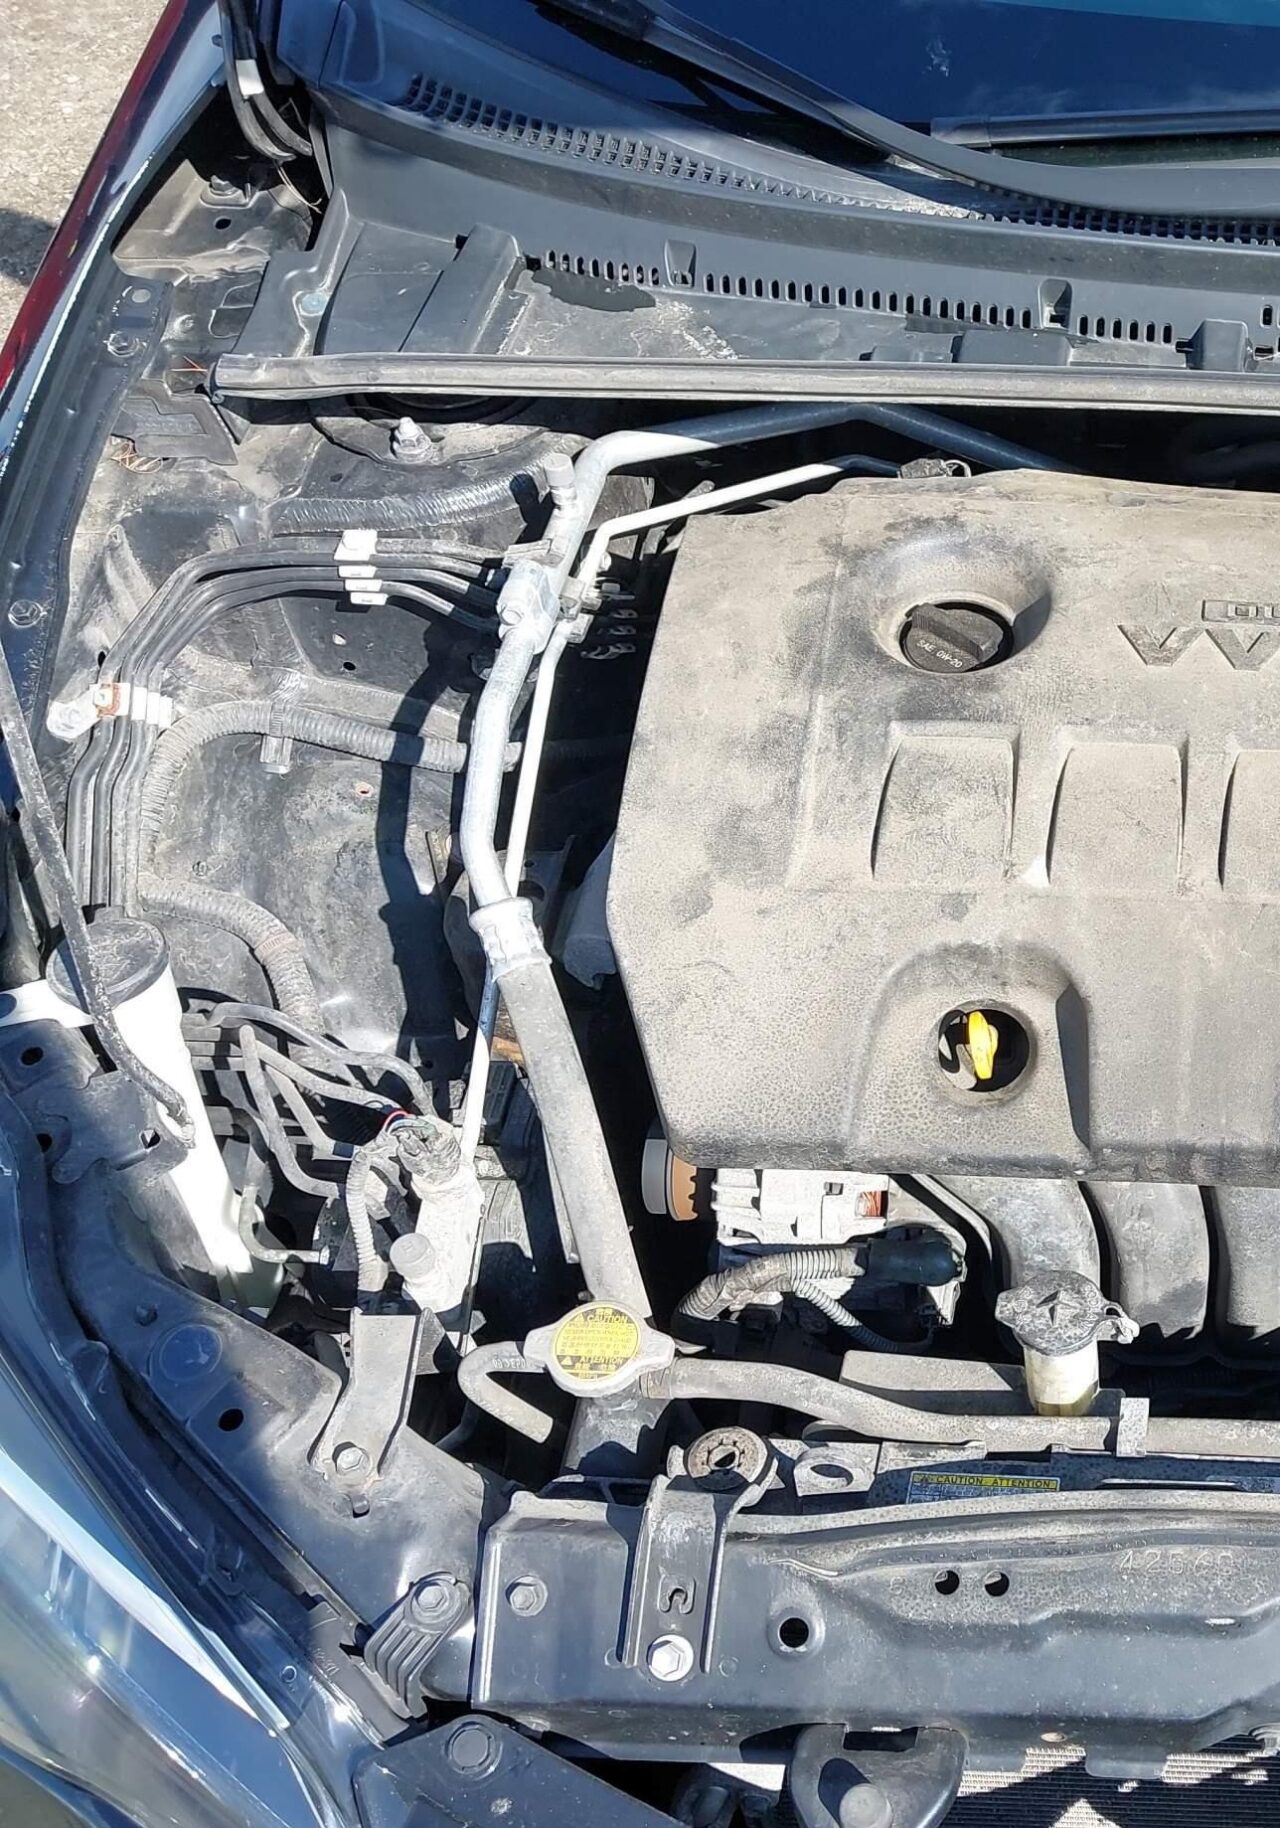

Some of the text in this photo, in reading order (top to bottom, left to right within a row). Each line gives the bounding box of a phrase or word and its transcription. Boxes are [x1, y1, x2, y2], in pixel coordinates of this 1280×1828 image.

[917, 640, 963, 668] SAE 0W-20
[587, 1314, 628, 1323] CAUTION
[936, 1476, 1050, 1488] CAUTION ATTENTION
